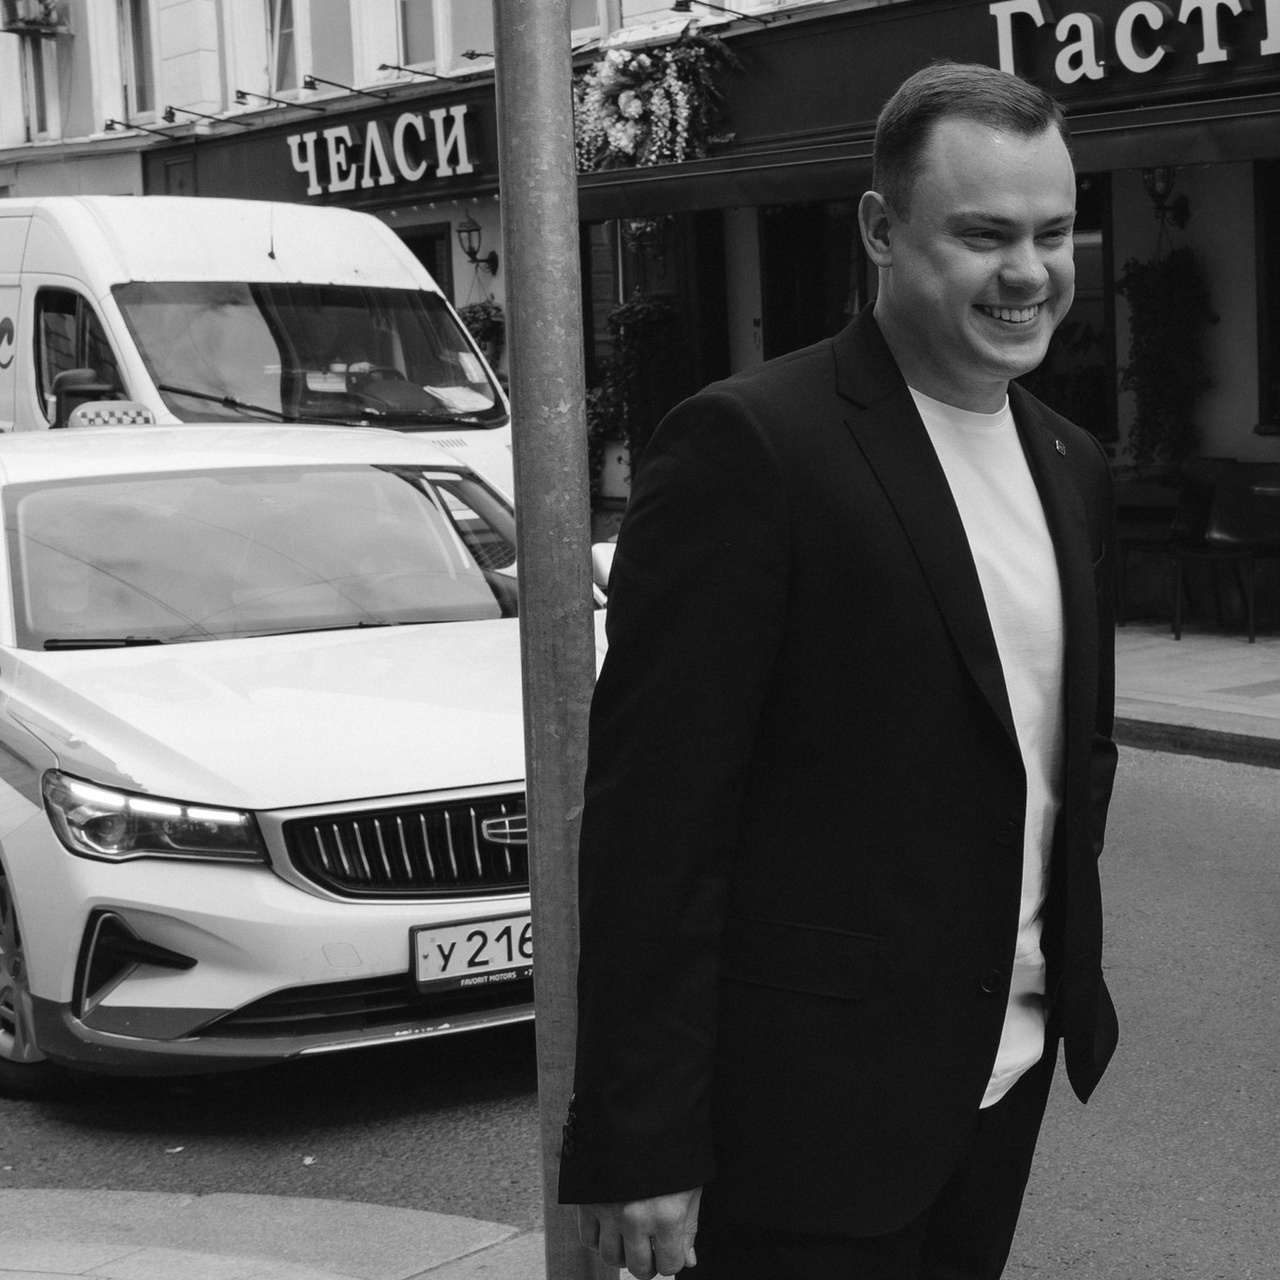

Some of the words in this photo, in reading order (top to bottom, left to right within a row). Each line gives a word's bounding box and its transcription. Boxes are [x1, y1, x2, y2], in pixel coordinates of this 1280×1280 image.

[287, 104, 475, 196] ЧЕЛСИ
[460, 975, 489, 987] FAVORIT
[489, 971, 517, 982] MOTORS
